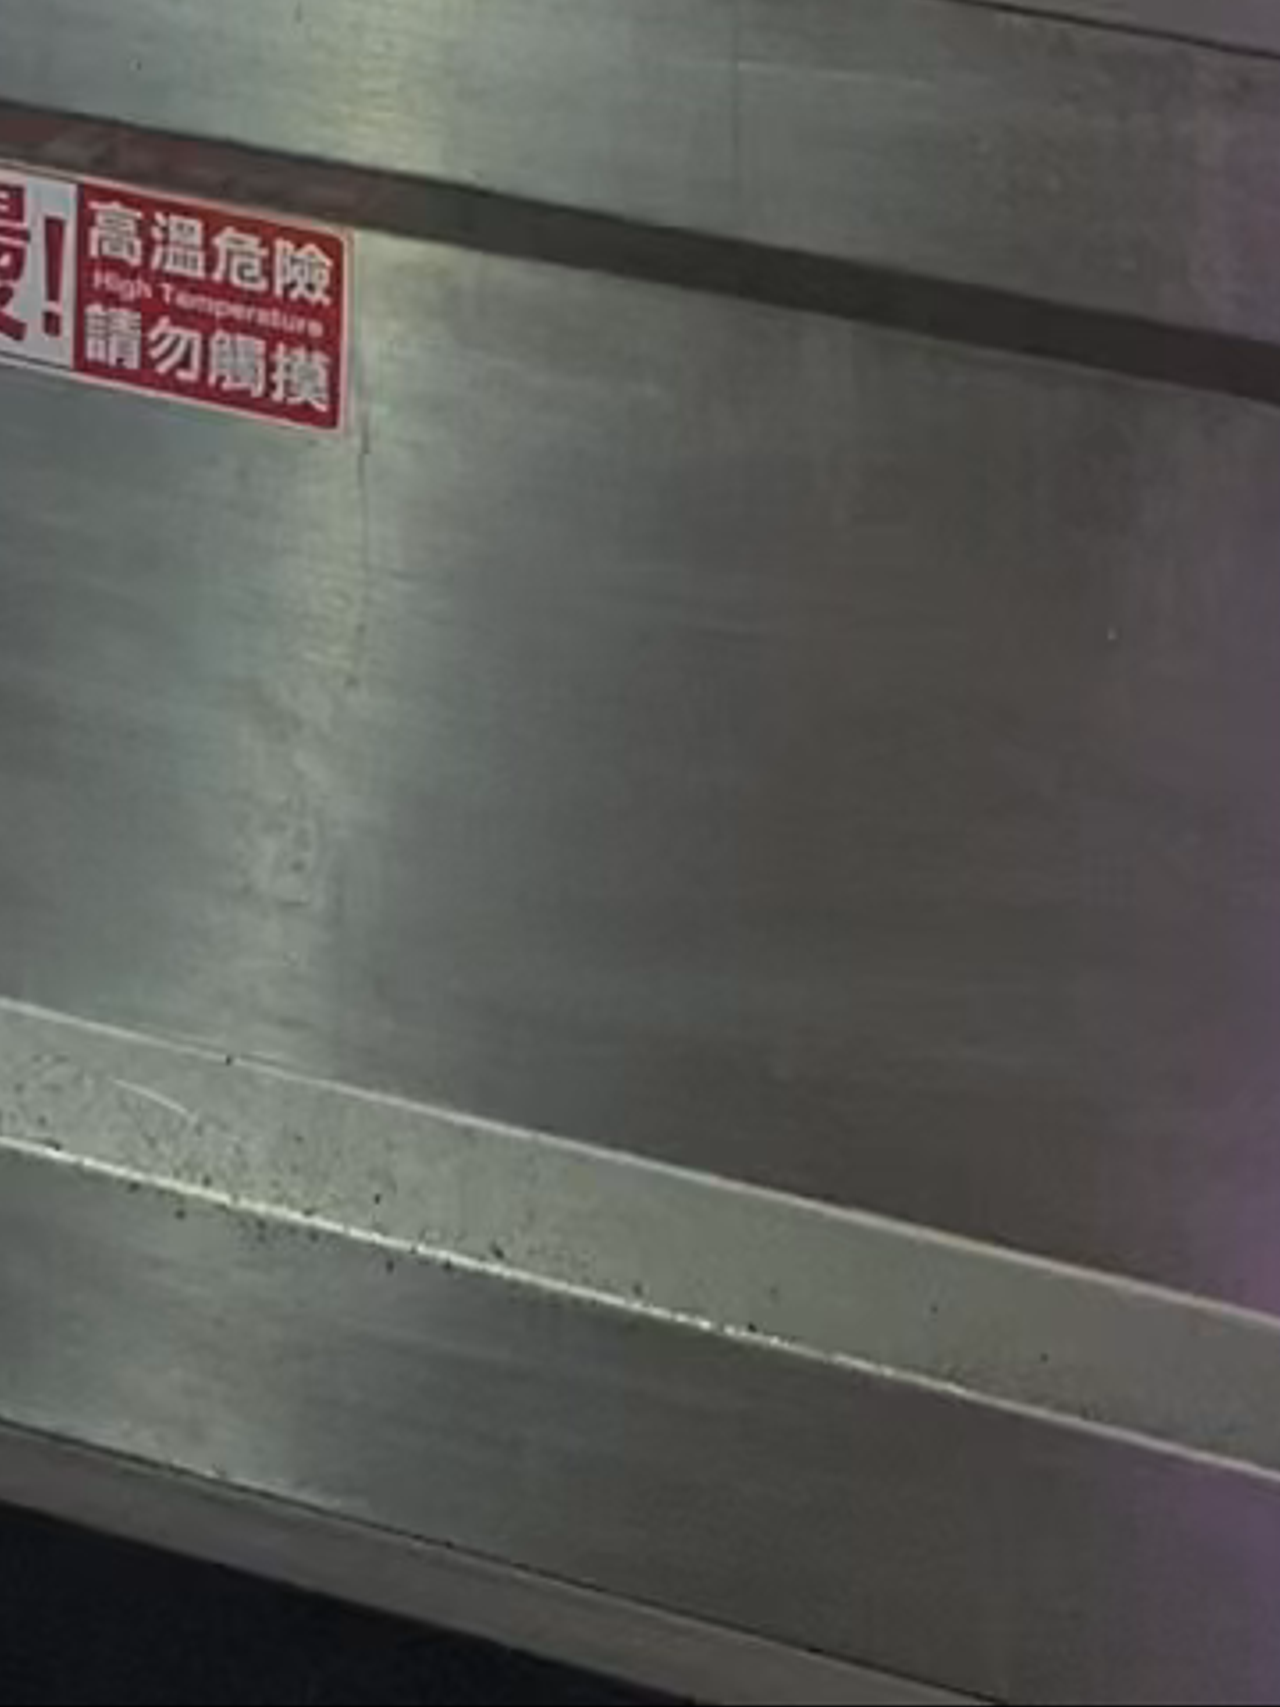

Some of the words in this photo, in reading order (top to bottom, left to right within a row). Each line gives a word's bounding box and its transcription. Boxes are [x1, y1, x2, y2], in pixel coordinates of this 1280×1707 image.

[88, 200, 332, 305] 高溫危險
[94, 268, 153, 299] High
[161, 282, 324, 337] Temperature
[84, 303, 329, 412] 請勿觸摸
